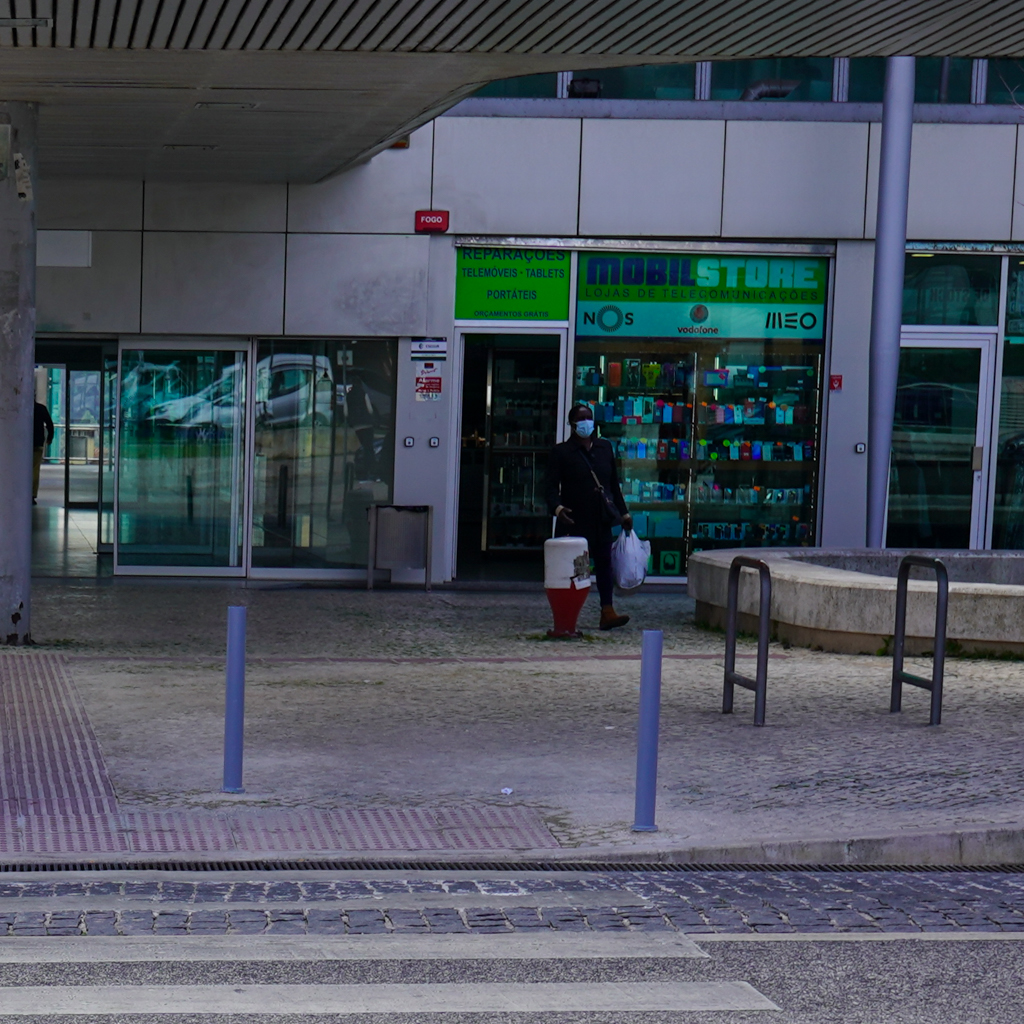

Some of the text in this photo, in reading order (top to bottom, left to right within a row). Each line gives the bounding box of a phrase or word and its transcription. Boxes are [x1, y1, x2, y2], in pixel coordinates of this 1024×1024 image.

[462, 266, 565, 278] TELEMÓVEIS TABLETS
[487, 287, 537, 300] PORTÁTEIS
[585, 288, 818, 302] LOJAS DE TELECOMUNICAÇÕES
[524, 310, 549, 318] GRÁTIS
[765, 312, 817, 330] MEO
